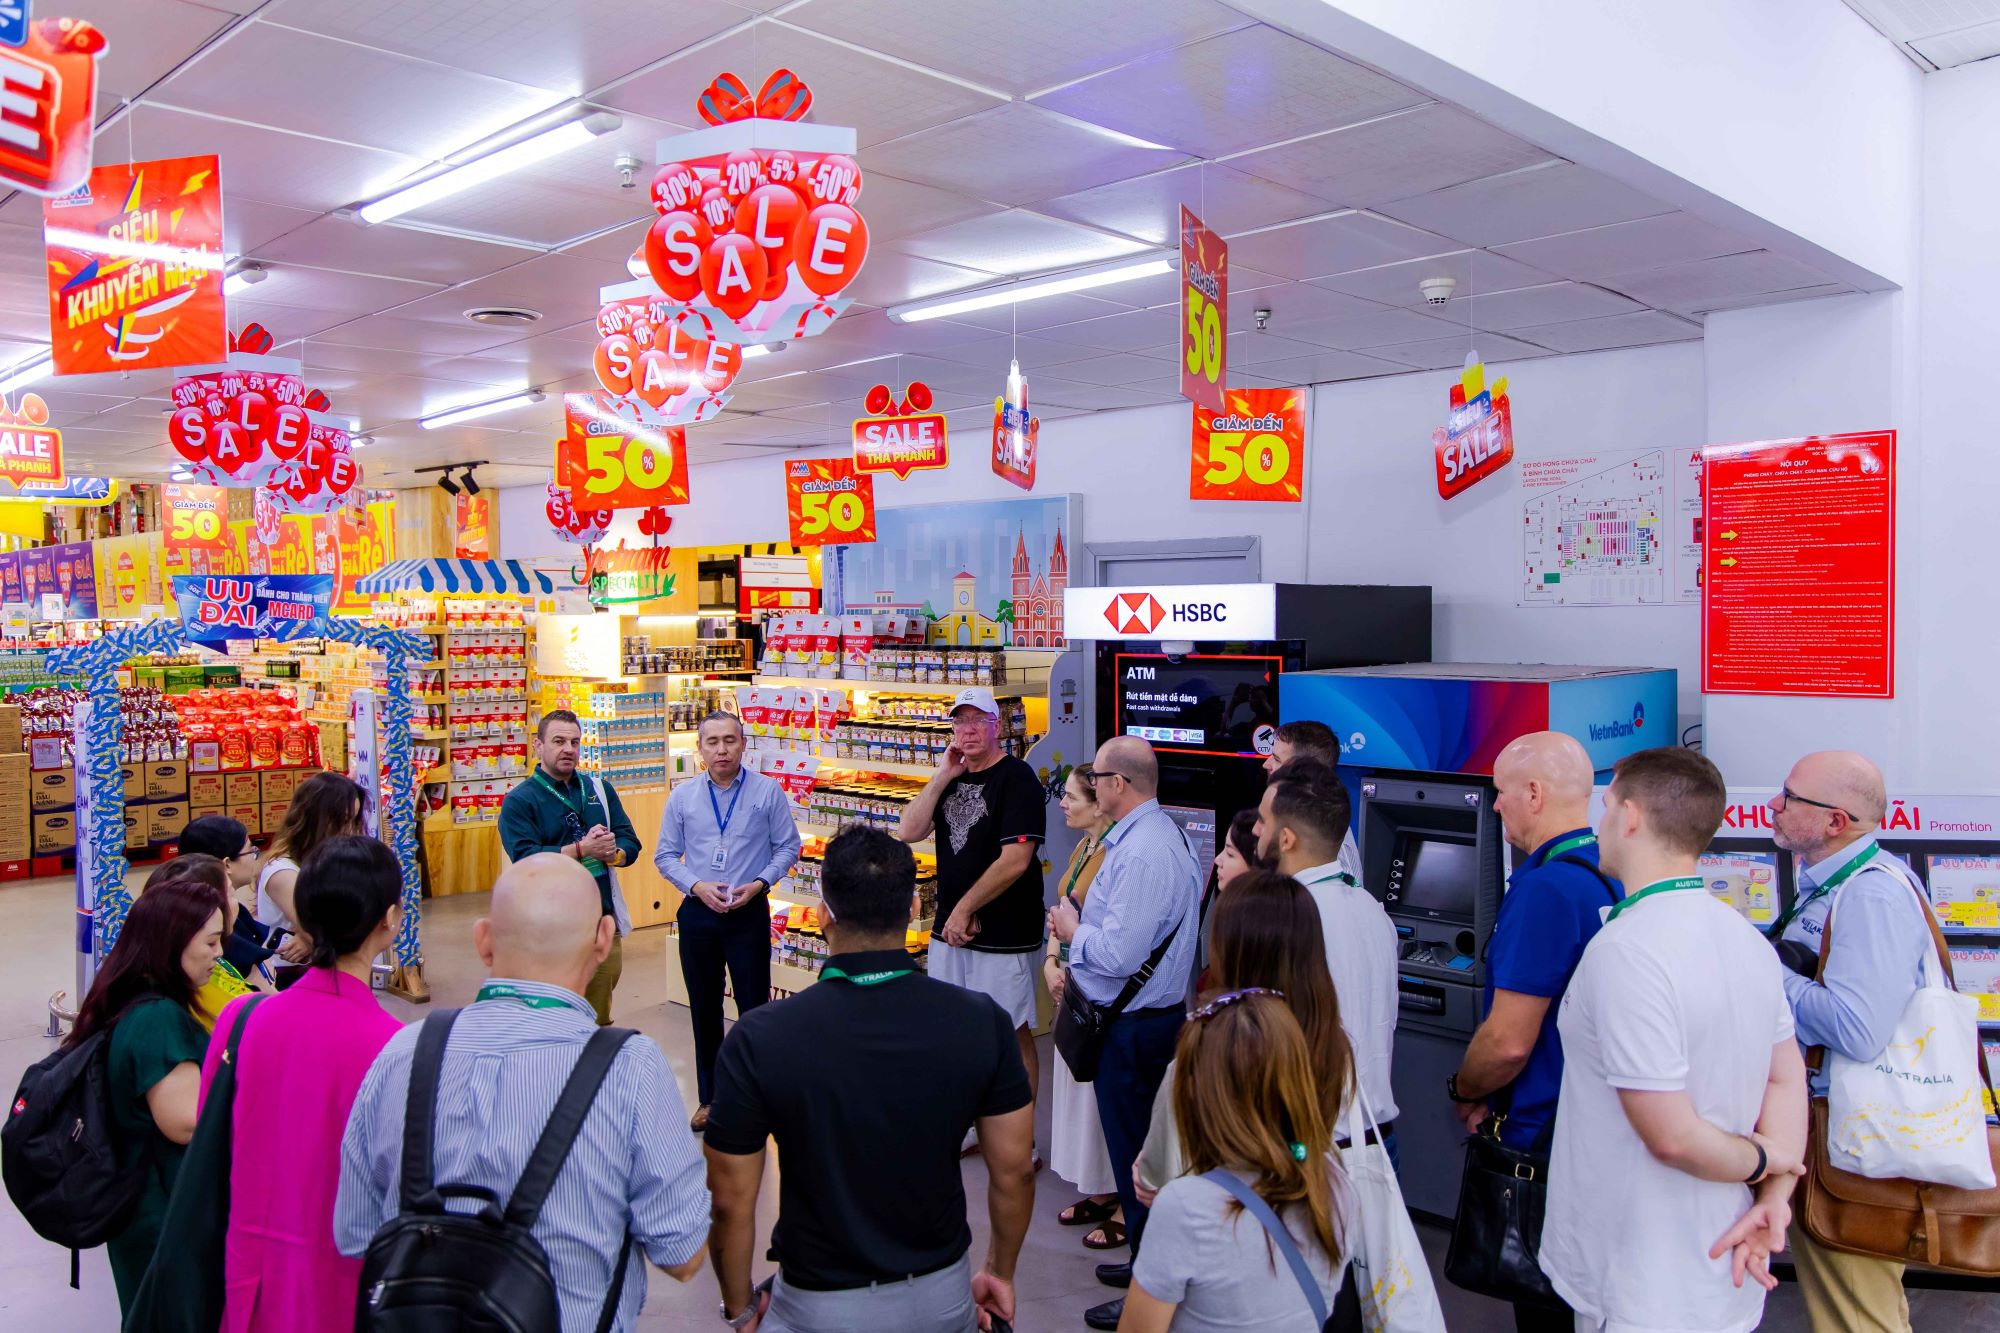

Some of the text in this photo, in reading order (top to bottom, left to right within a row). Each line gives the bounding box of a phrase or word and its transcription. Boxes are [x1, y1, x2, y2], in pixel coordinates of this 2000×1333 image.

[664, 195, 853, 296] SALE
[607, 325, 732, 391] SALE
[181, 399, 299, 460] SALE
[1213, 413, 1284, 431] GIẢM ĐẾN
[0, 431, 51, 458] ALE
[865, 421, 935, 449] SALE
[893, 449, 936, 463] PHANH
[1442, 415, 1503, 483] SALE
[289, 444, 350, 490] ALE
[802, 476, 857, 492] GIẢM ĐẾN
[206, 578, 252, 604] ƯU
[592, 574, 659, 591] SPECIALTY
[197, 600, 256, 627] ĐÃI
[268, 600, 315, 620] MCARD
[1172, 603, 1228, 622] HSBC
[1126, 666, 1156, 680] ATM
[1930, 821, 1993, 832] Promotion
[853, 970, 894, 983] STRALIA
[1875, 1064, 1954, 1085] AUTRALIA
